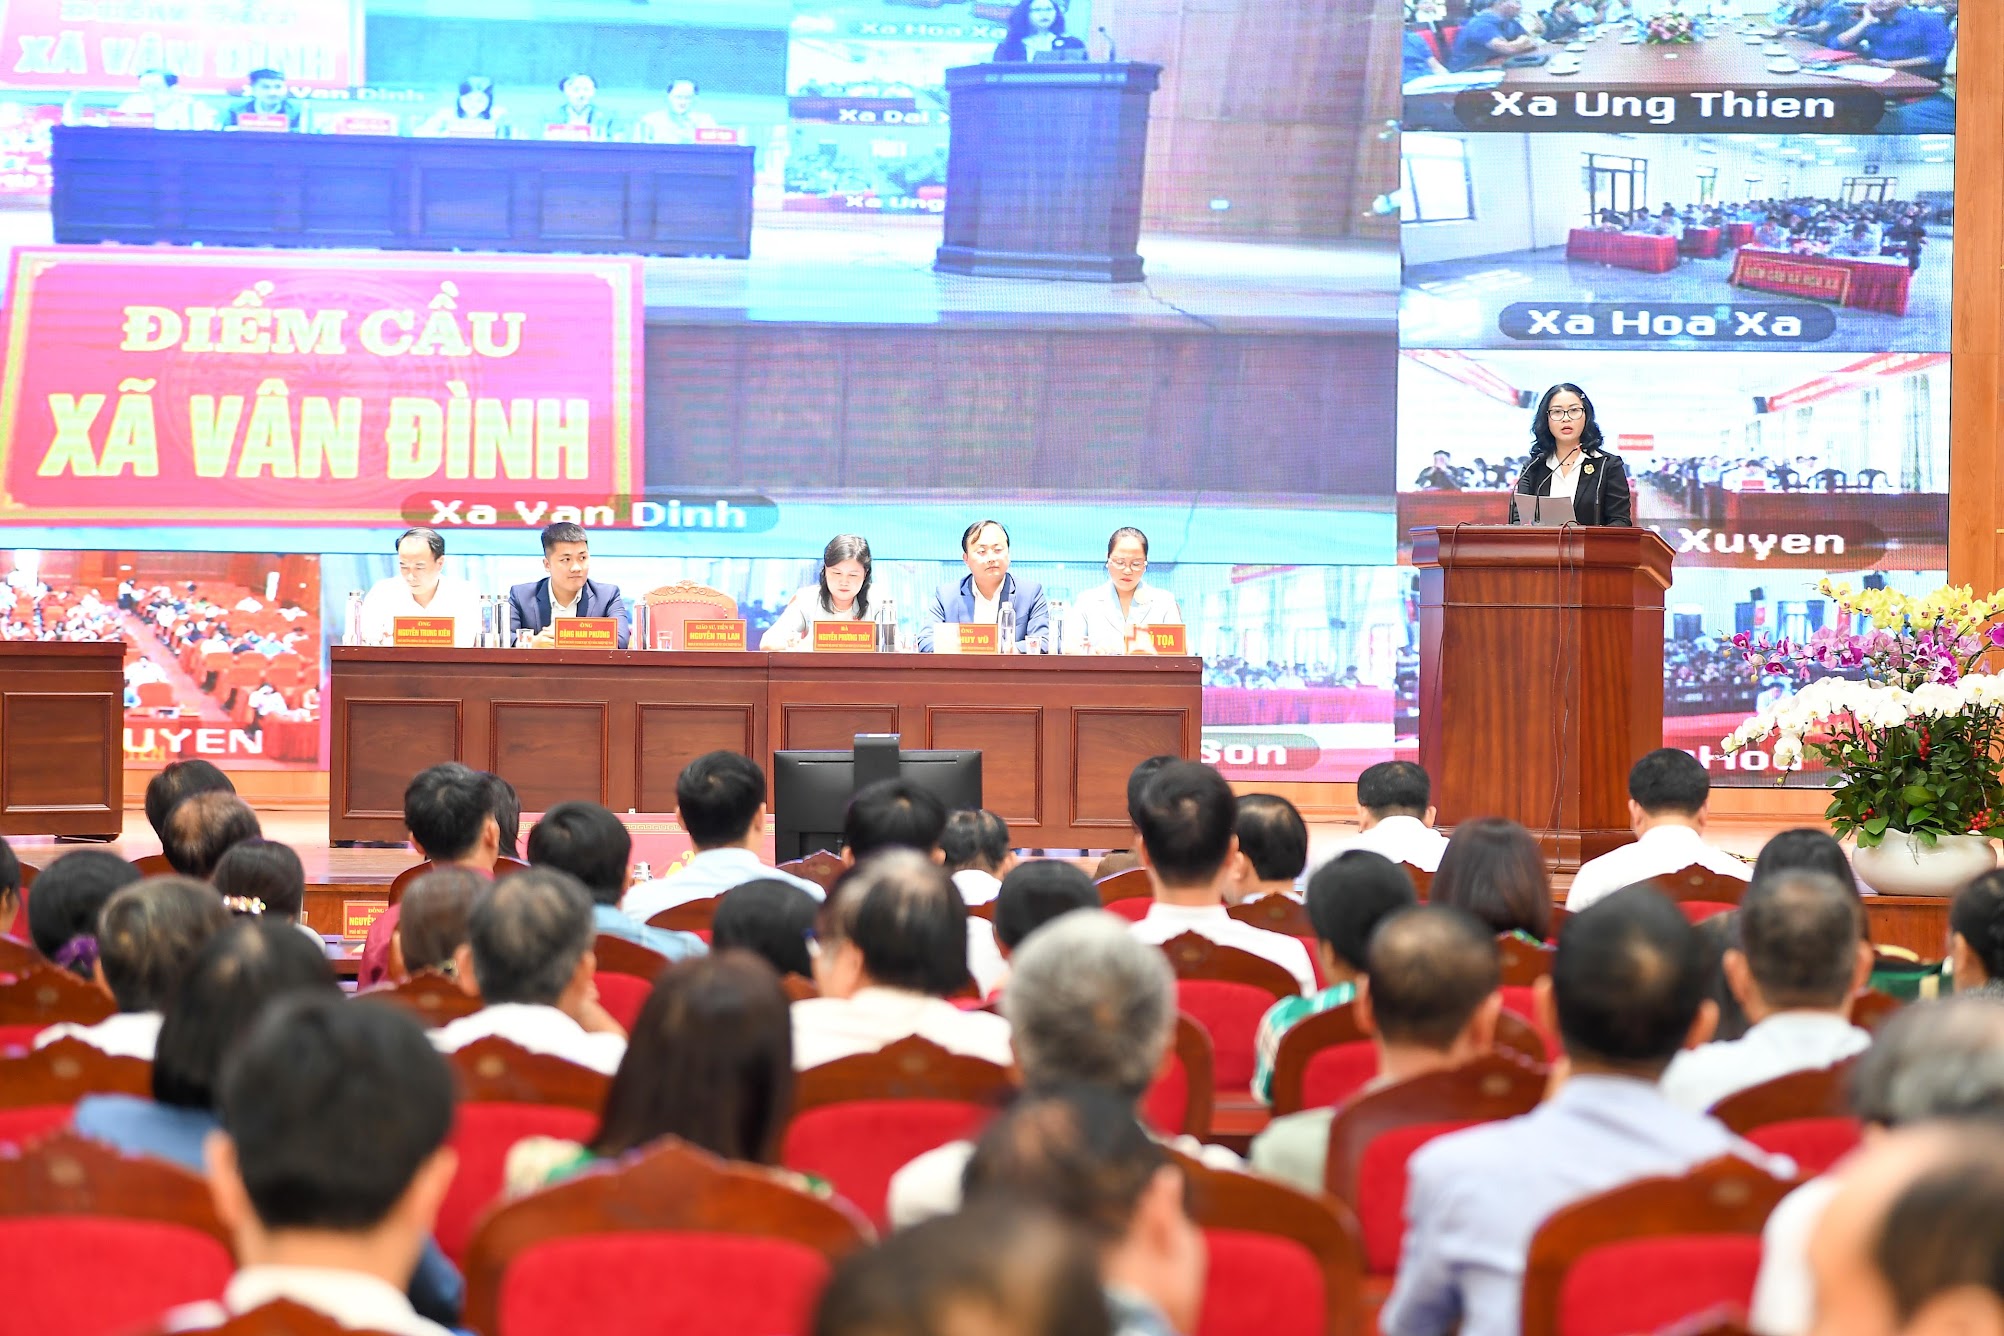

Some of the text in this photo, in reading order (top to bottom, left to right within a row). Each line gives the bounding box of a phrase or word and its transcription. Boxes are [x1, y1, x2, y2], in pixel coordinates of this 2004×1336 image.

[838, 109, 877, 123] Xa
[1491, 91, 1836, 124] Xa Ung Thien
[120, 280, 527, 357] ĐIỂM CẦU
[1527, 311, 1803, 338] Xa Hoa Xa
[37, 377, 590, 480] XÃ VÂN ĐÌNH
[430, 500, 747, 528] Xa Van Dinh
[1677, 527, 1845, 561] Xuyen
[690, 630, 715, 640] NGUYỄN
[728, 632, 740, 641] LAN
[1157, 634, 1175, 649] TỌA
